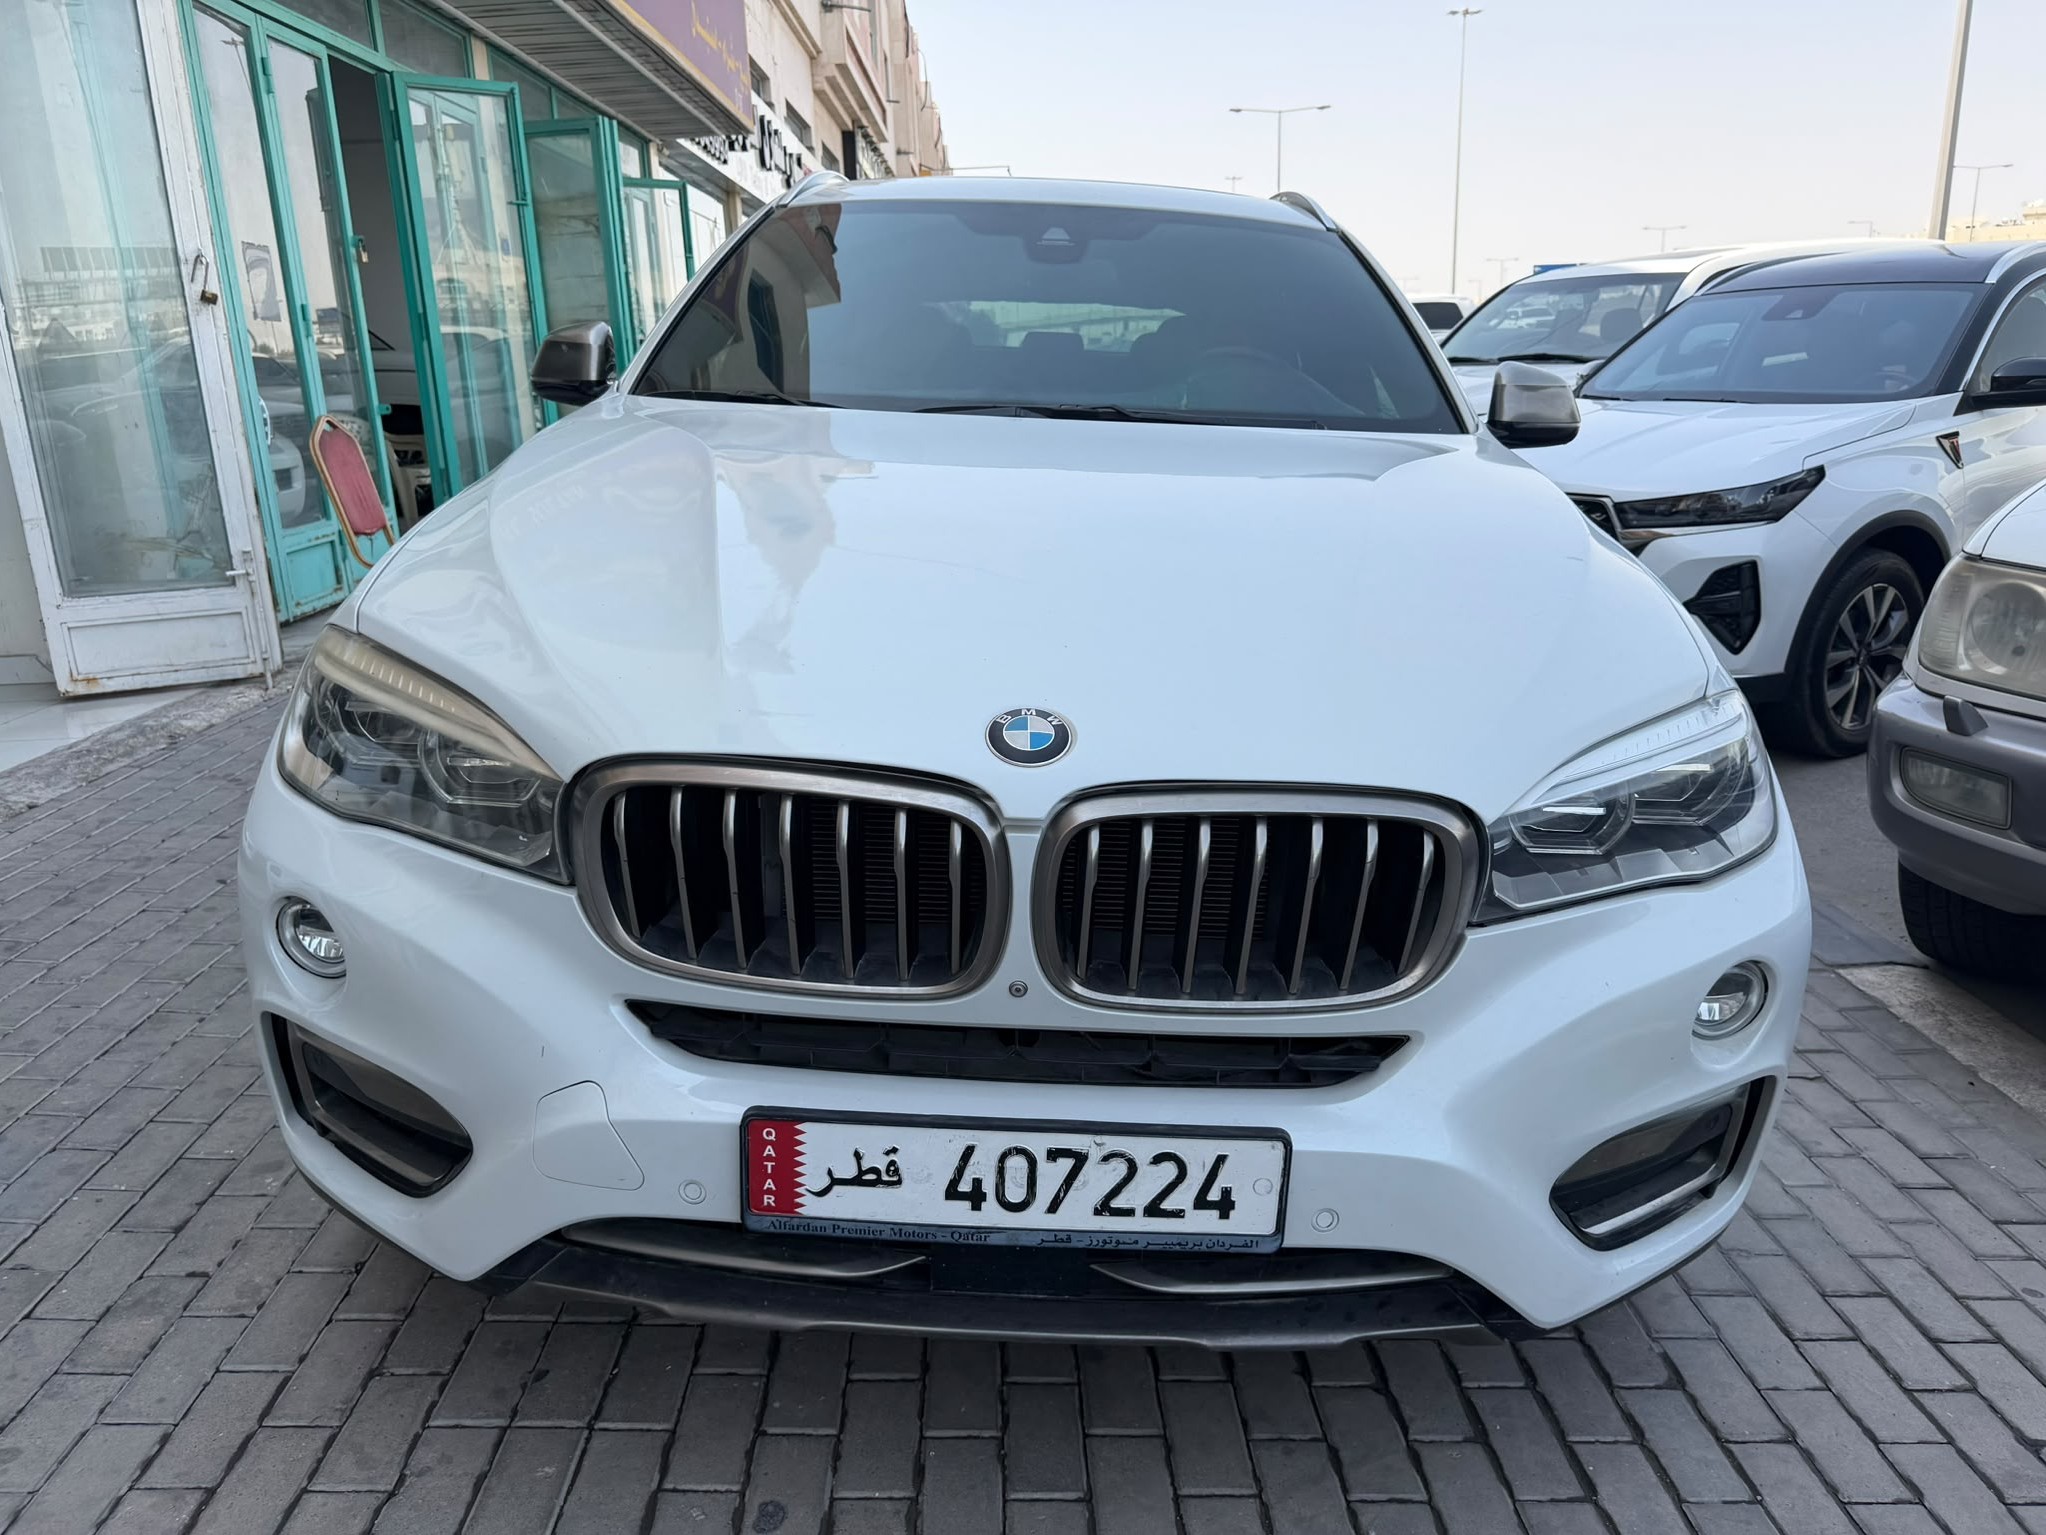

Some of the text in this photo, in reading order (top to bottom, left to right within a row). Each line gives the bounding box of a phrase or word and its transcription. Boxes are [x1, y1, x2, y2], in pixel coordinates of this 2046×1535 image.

[996, 708, 1063, 725] BMW
[762, 1127, 777, 1207] QATAR
[804, 1145, 903, 1198] قطر
[943, 1143, 1236, 1221] 407224
[766, 1218, 828, 1234] Alfardan
[831, 1223, 885, 1237] Premier
[889, 1227, 938, 1240] Motors
[949, 1230, 991, 1243] Qatar
[1037, 1234, 1072, 1247] قطر
